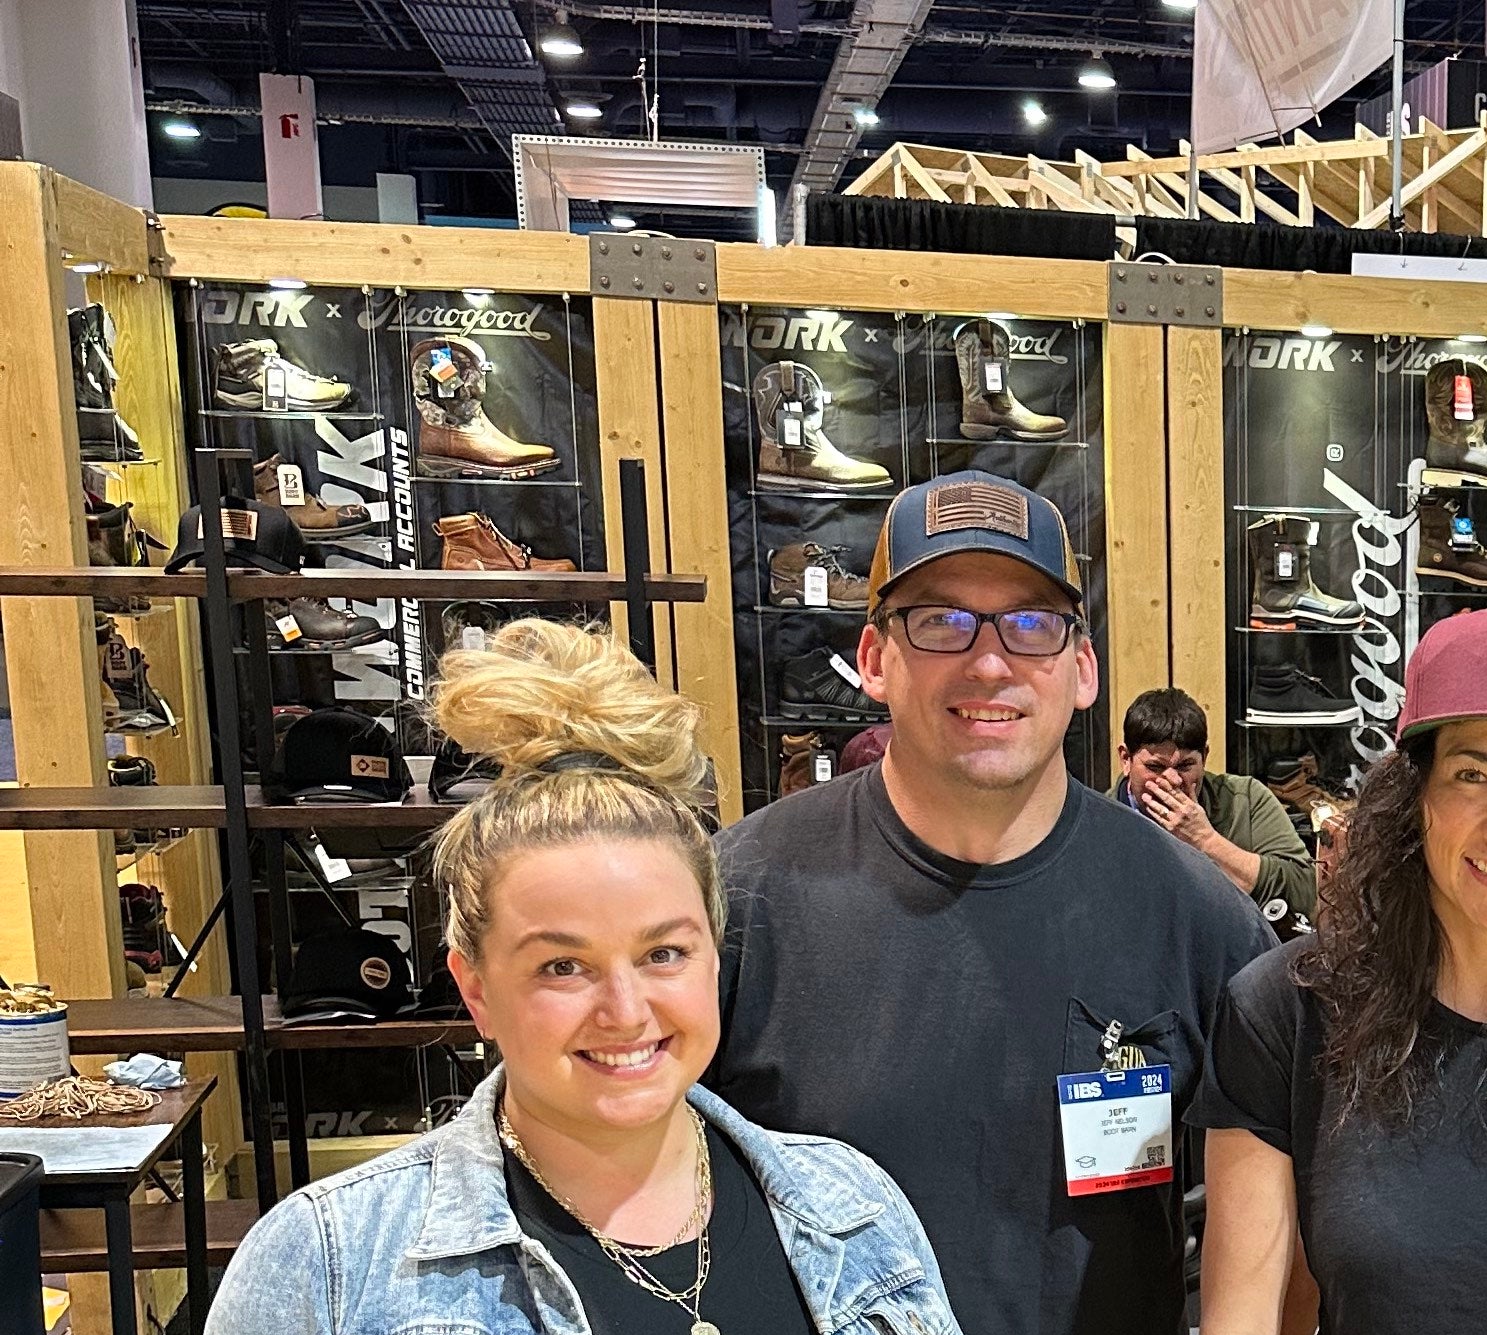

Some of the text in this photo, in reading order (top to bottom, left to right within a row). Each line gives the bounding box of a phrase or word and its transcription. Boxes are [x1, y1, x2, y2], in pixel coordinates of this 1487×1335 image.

[186, 290, 315, 329] ORK
[357, 292, 551, 341] Thorogood
[1223, 336, 1343, 372] WORK
[389, 425, 425, 701] COMMERCL ACCOUNTS
[1073, 1081, 1102, 1099] IBS
[1141, 1073, 1163, 1087] 2024
[1108, 1107, 1128, 1118] JEFF
